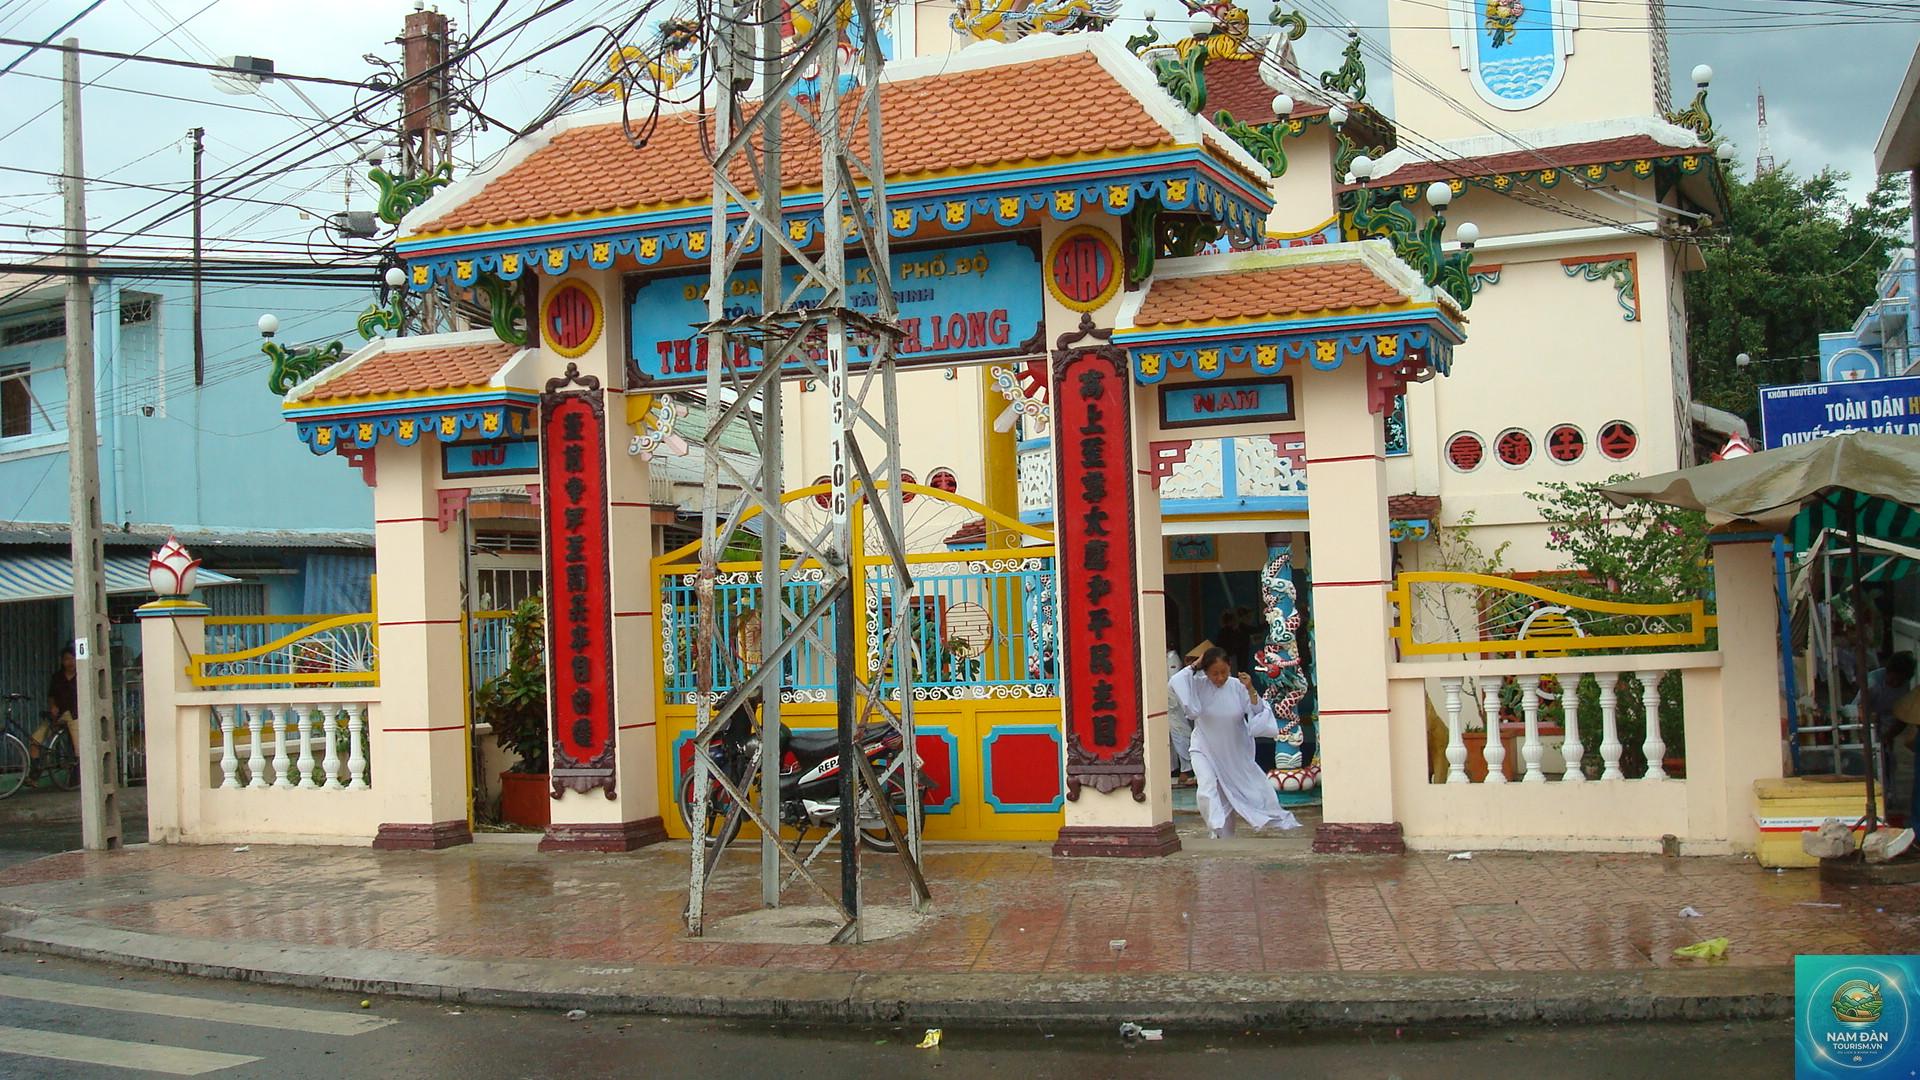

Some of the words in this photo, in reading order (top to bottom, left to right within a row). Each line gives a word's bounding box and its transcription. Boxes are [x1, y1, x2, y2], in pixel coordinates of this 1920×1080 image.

[1193, 390, 1259, 413] NAM
[1825, 398, 1868, 422] TOÀN
[1871, 395, 1904, 418] DÂN
[79, 643, 85, 656] 6
